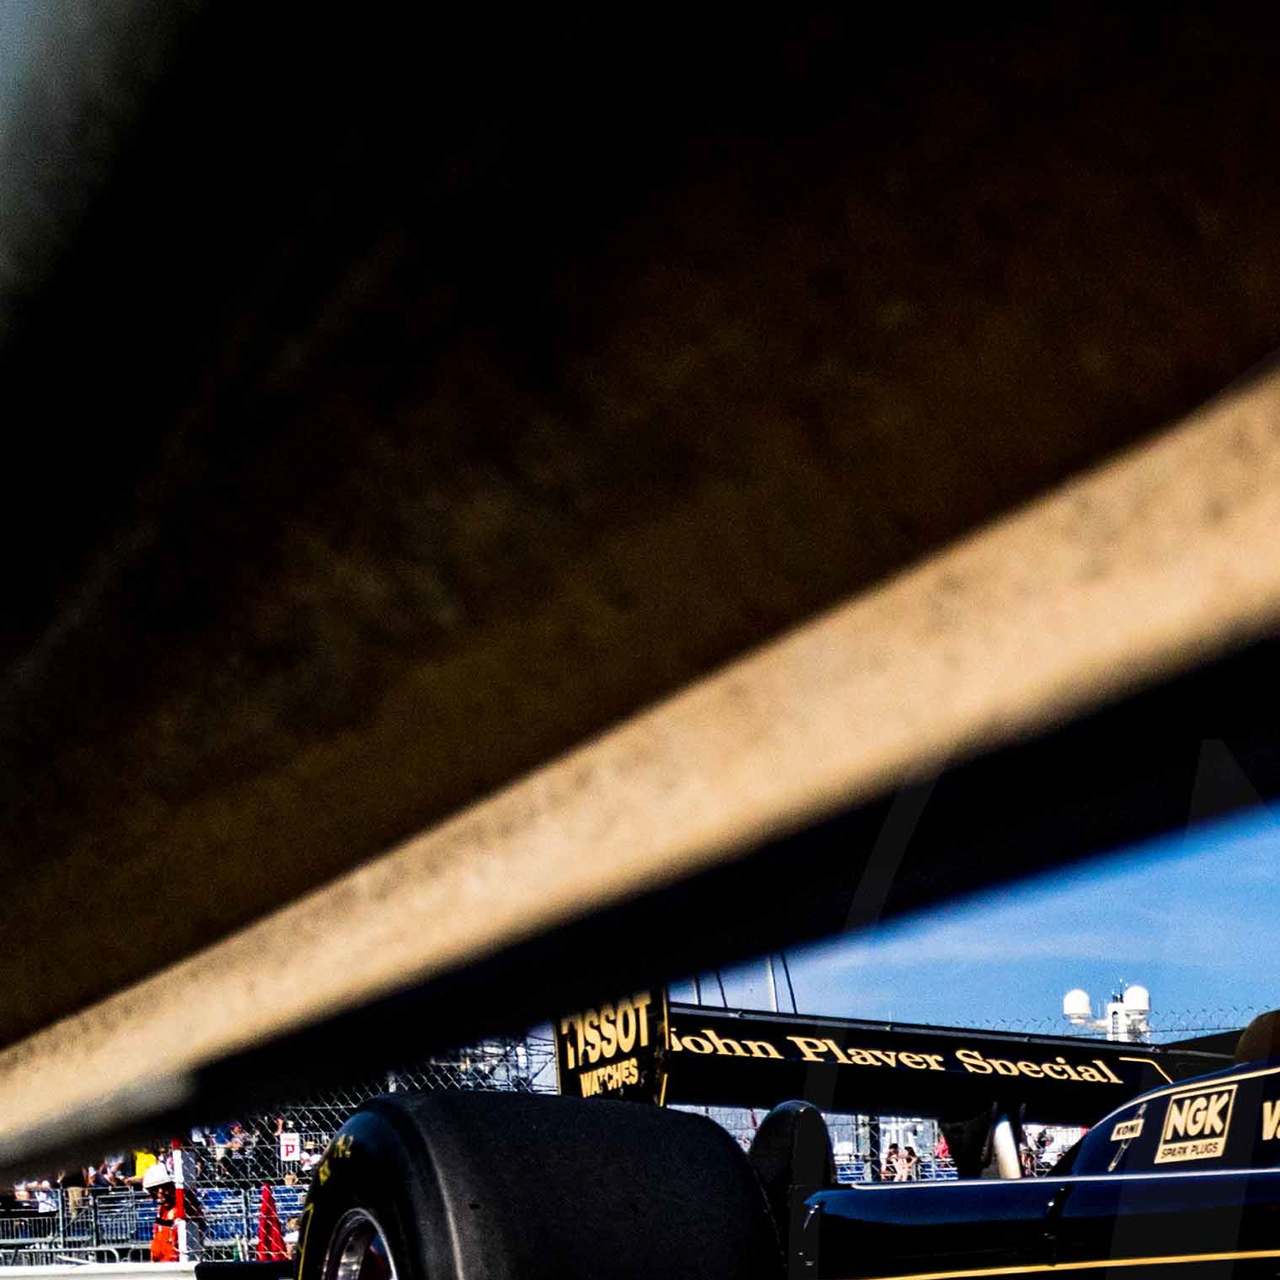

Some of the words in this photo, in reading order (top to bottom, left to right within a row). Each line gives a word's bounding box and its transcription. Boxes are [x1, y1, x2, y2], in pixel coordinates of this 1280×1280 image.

[561, 993, 652, 1070] TISSOT
[579, 1057, 640, 1099] WATCHES
[786, 1035, 945, 1072] Player
[954, 1049, 1125, 1085] Special
[1114, 1122, 1141, 1137] KONI
[1164, 1092, 1230, 1140] NGK
[1160, 1146, 1188, 1159] SPARK
[1190, 1142, 1219, 1156] PLUGS
